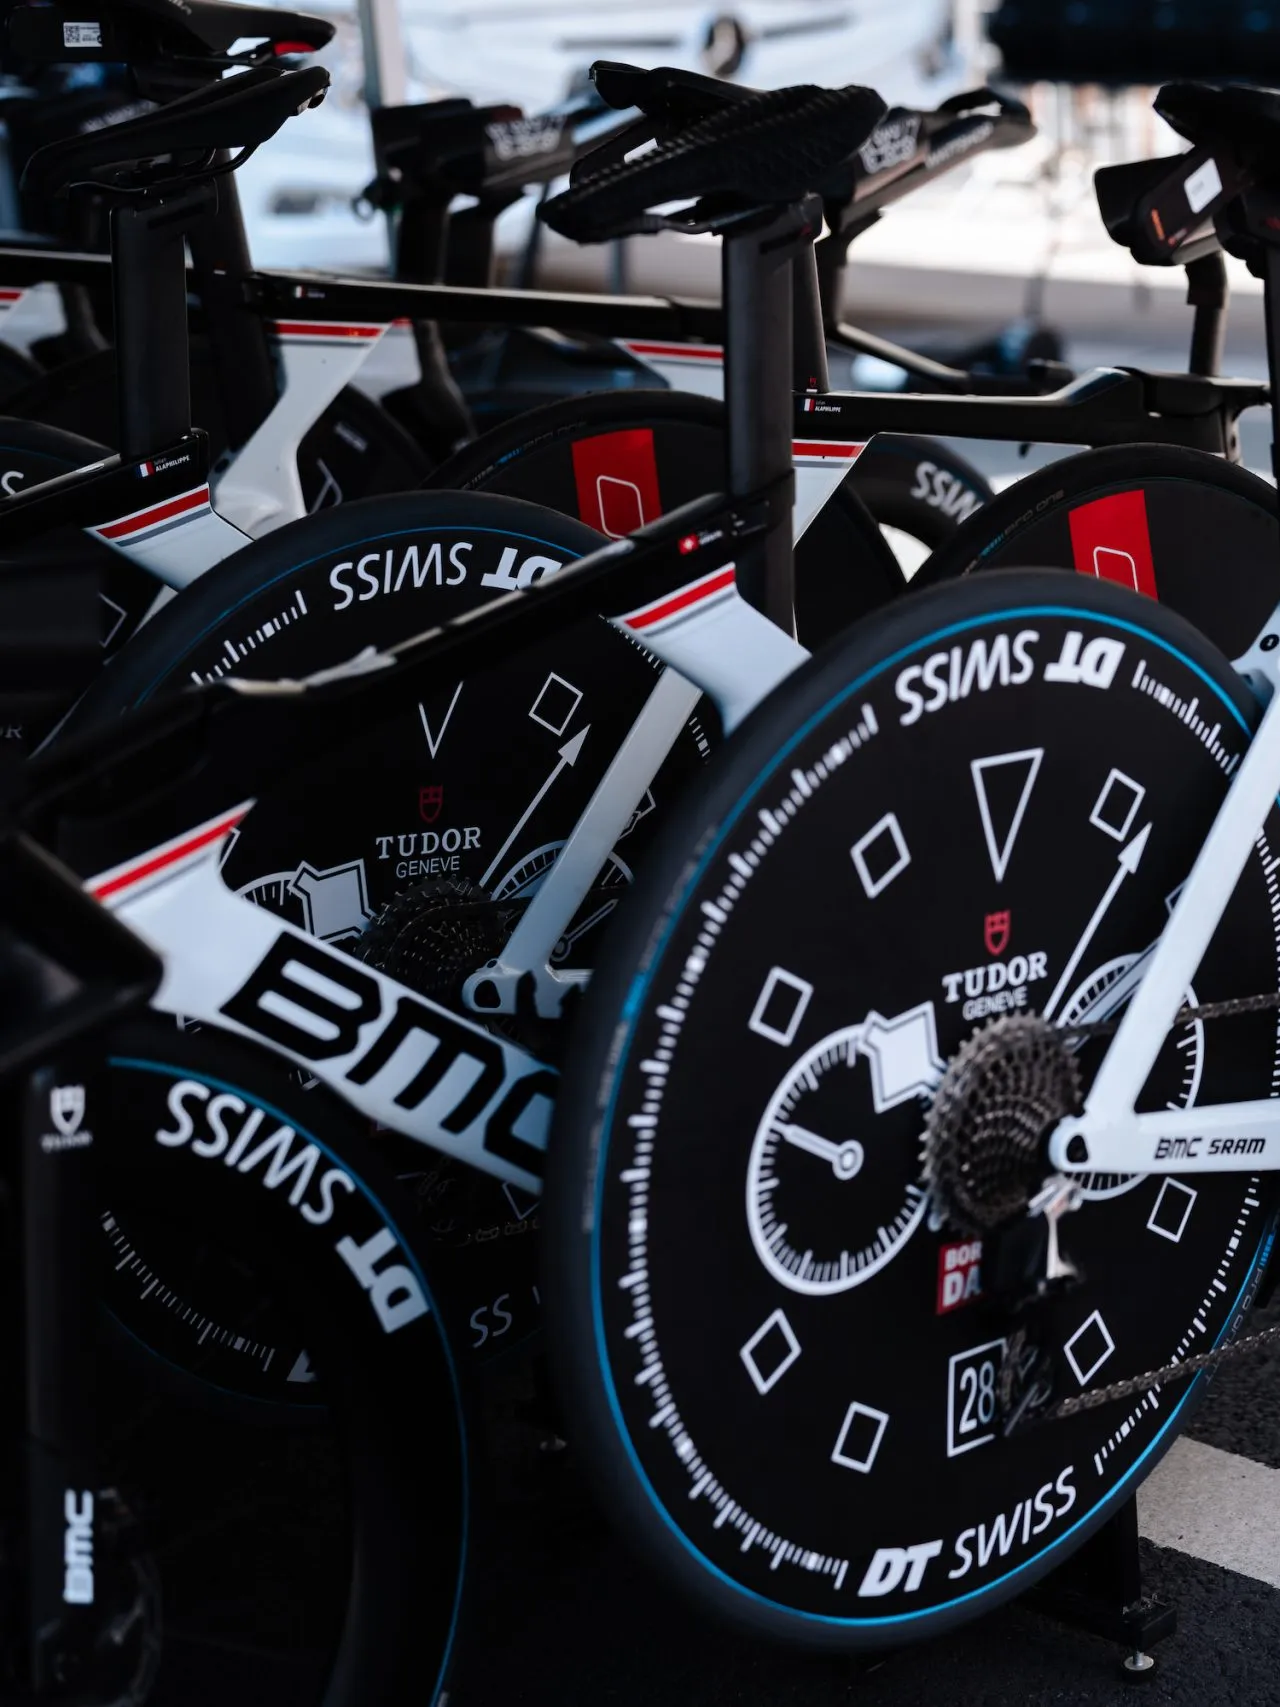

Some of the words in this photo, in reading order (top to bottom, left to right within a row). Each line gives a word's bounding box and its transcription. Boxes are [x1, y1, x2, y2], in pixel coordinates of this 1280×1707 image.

[909, 460, 986, 526] WISS
[329, 541, 473, 611] SWISS
[895, 628, 1040, 727] SWISS
[1043, 630, 1127, 690] DT
[375, 826, 482, 860] TUDOR
[395, 855, 461, 879] GENEVE
[941, 950, 1049, 1004] TUDOR
[961, 985, 1028, 1021] GENEVE
[219, 931, 558, 1177] BMC
[154, 1079, 357, 1226] SWISS
[1154, 1137, 1203, 1160] BMC
[1207, 1137, 1267, 1156] SRAM
[333, 1226, 431, 1335] DT
[941, 1263, 985, 1309] DA
[944, 1239, 985, 1272] BOR
[958, 1359, 997, 1435] 28
[857, 1538, 944, 1598] DT
[948, 1464, 1077, 1580] SWISS
